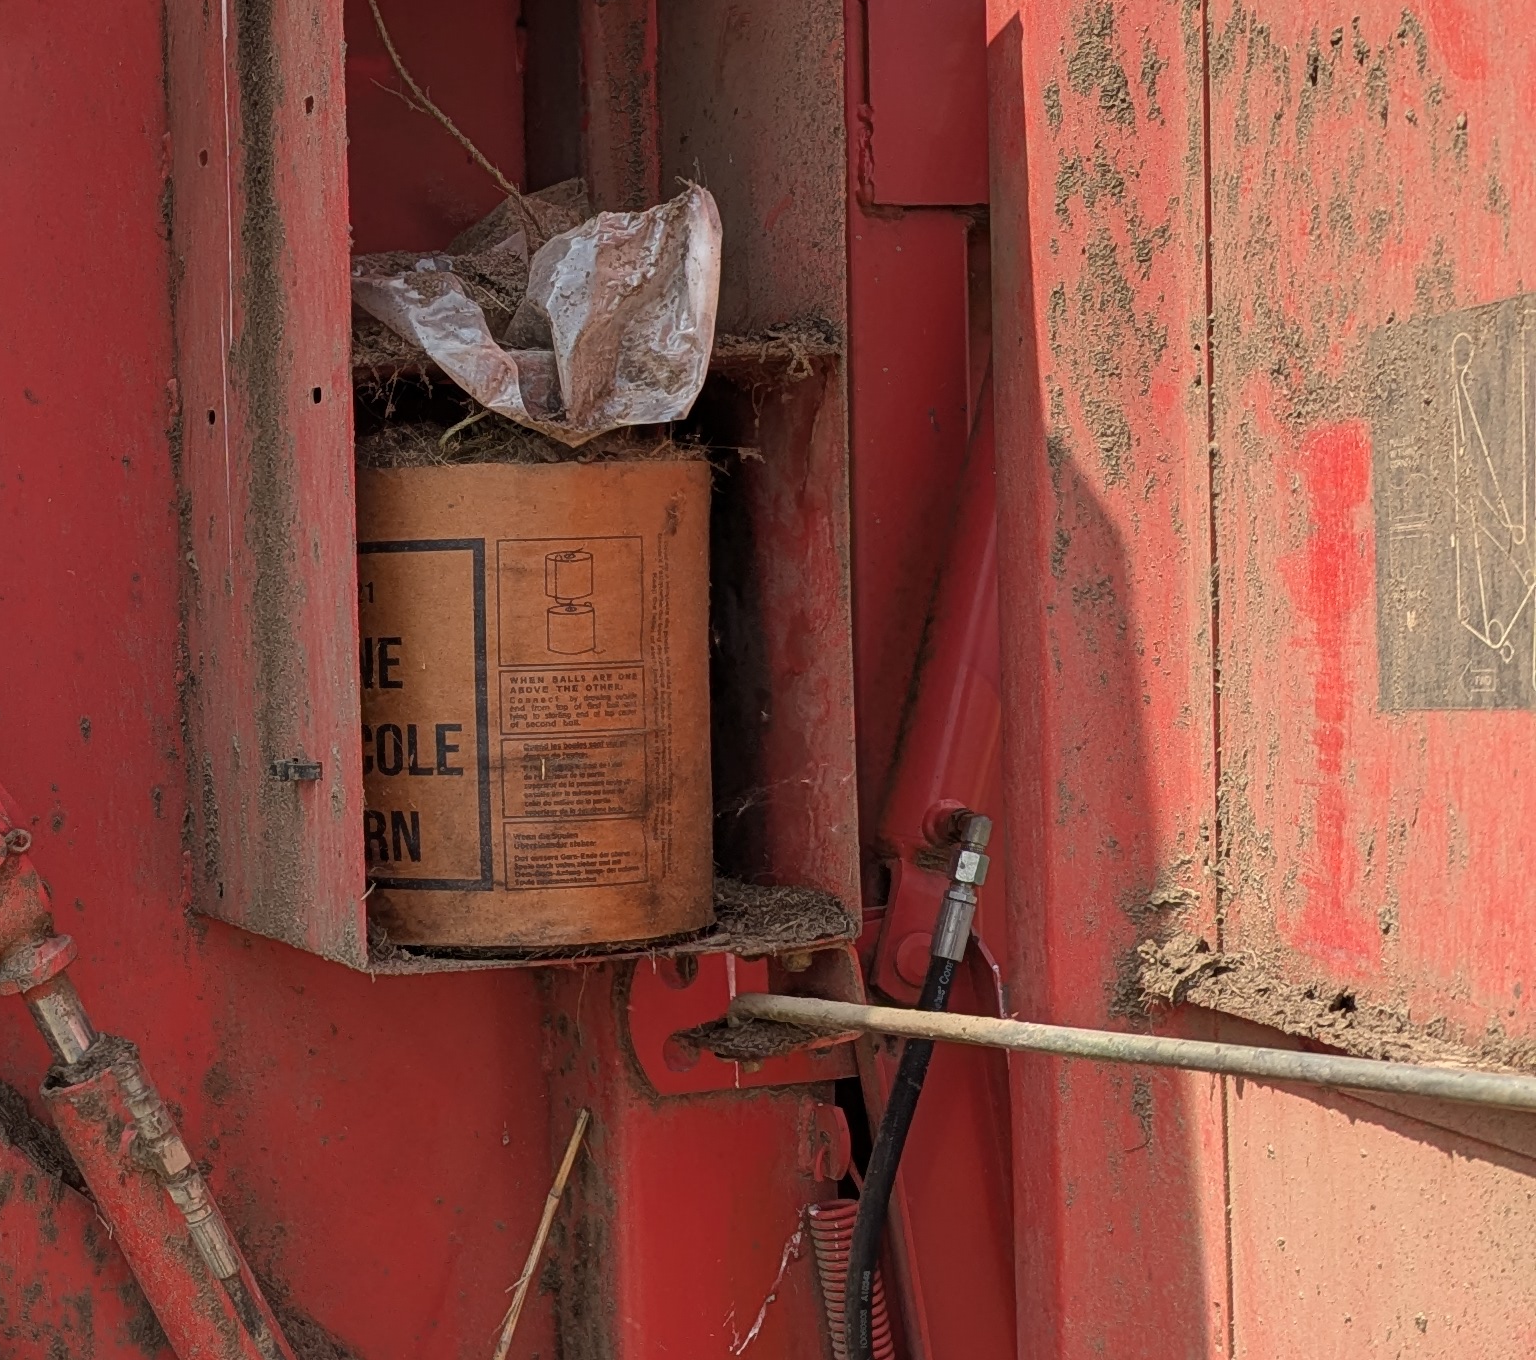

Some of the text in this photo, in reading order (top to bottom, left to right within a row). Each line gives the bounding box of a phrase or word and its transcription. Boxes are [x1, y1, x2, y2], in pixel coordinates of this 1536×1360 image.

[510, 672, 638, 684] WHEN BALLS ARE ONE
[510, 686, 549, 694] ABOVE
[556, 685, 579, 693] THE
[509, 696, 560, 704] Connect
[531, 704, 551, 712] from
[526, 720, 557, 728] second
